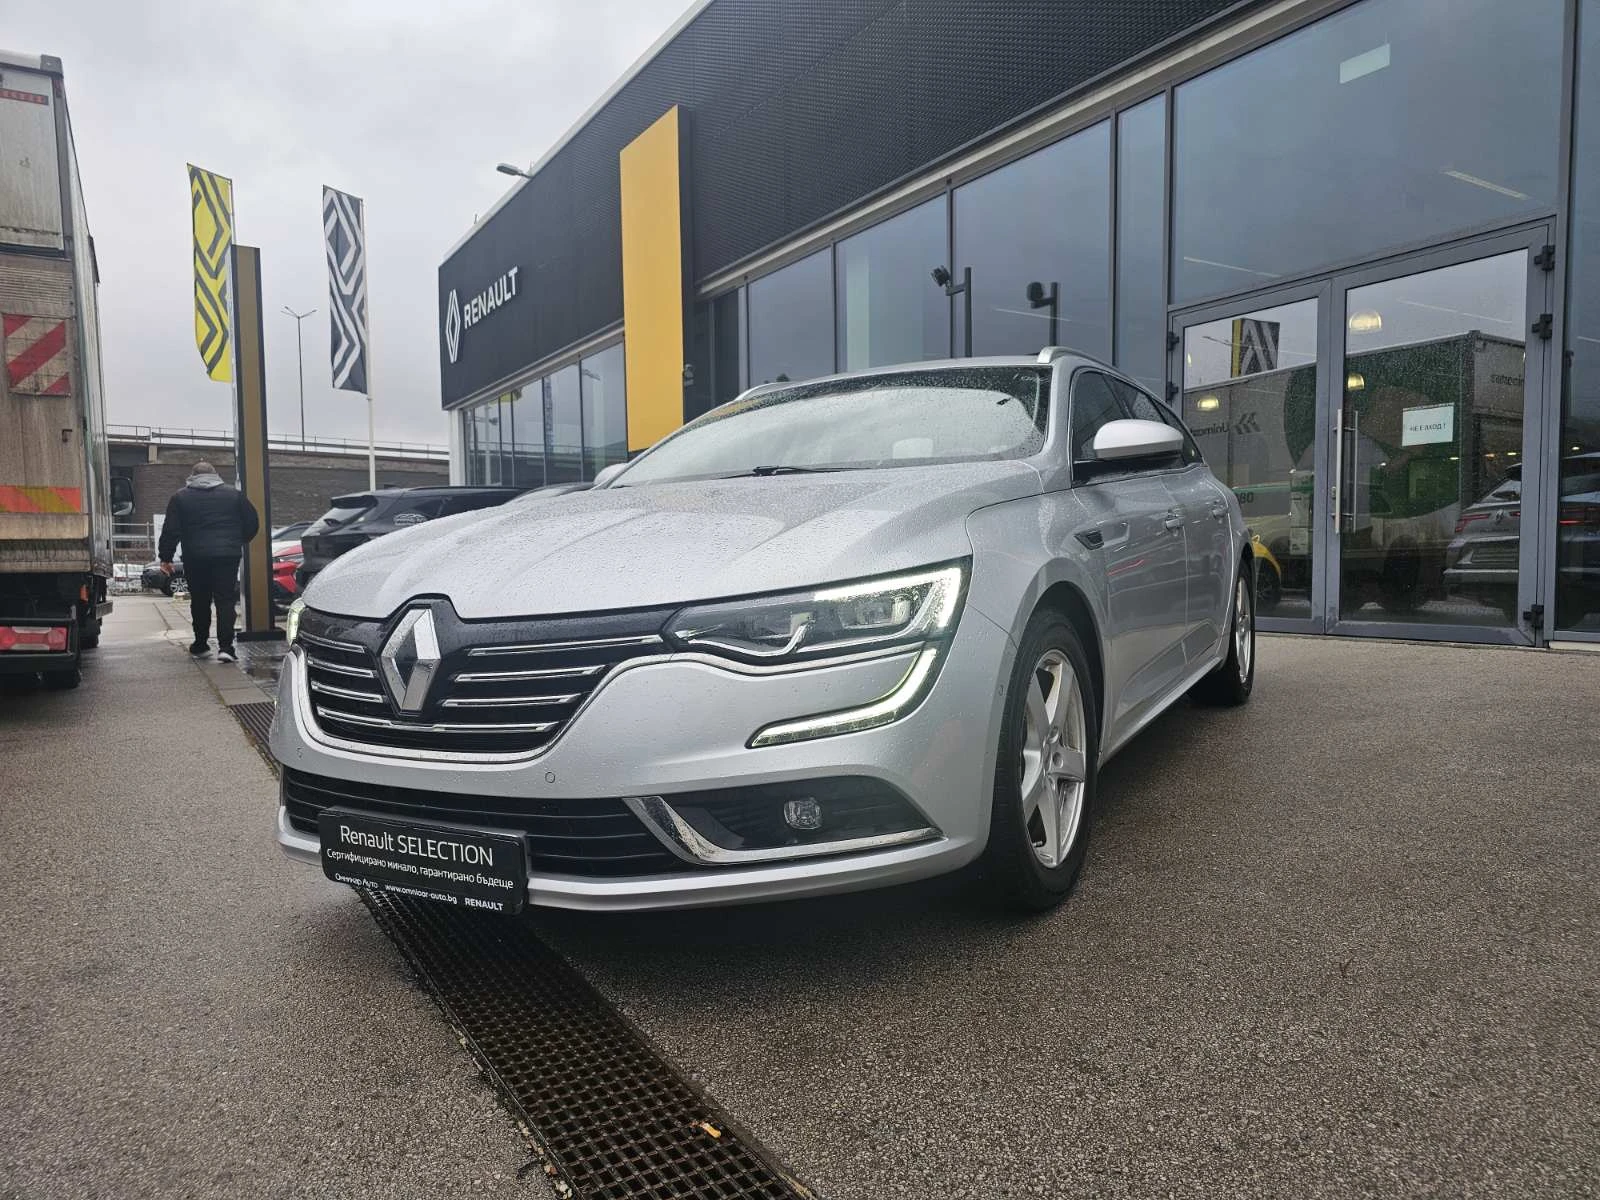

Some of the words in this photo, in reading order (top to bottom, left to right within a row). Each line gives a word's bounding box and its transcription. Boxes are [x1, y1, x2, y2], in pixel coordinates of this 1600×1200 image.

[463, 265, 518, 330] RENAULT
[340, 825, 395, 852] Renault
[397, 835, 494, 867] SELECTION
[326, 848, 387, 867] Сертифицирано
[420, 866, 475, 882] гарантирано
[476, 873, 514, 890] бъдеще
[464, 897, 504, 911] RENAULT
